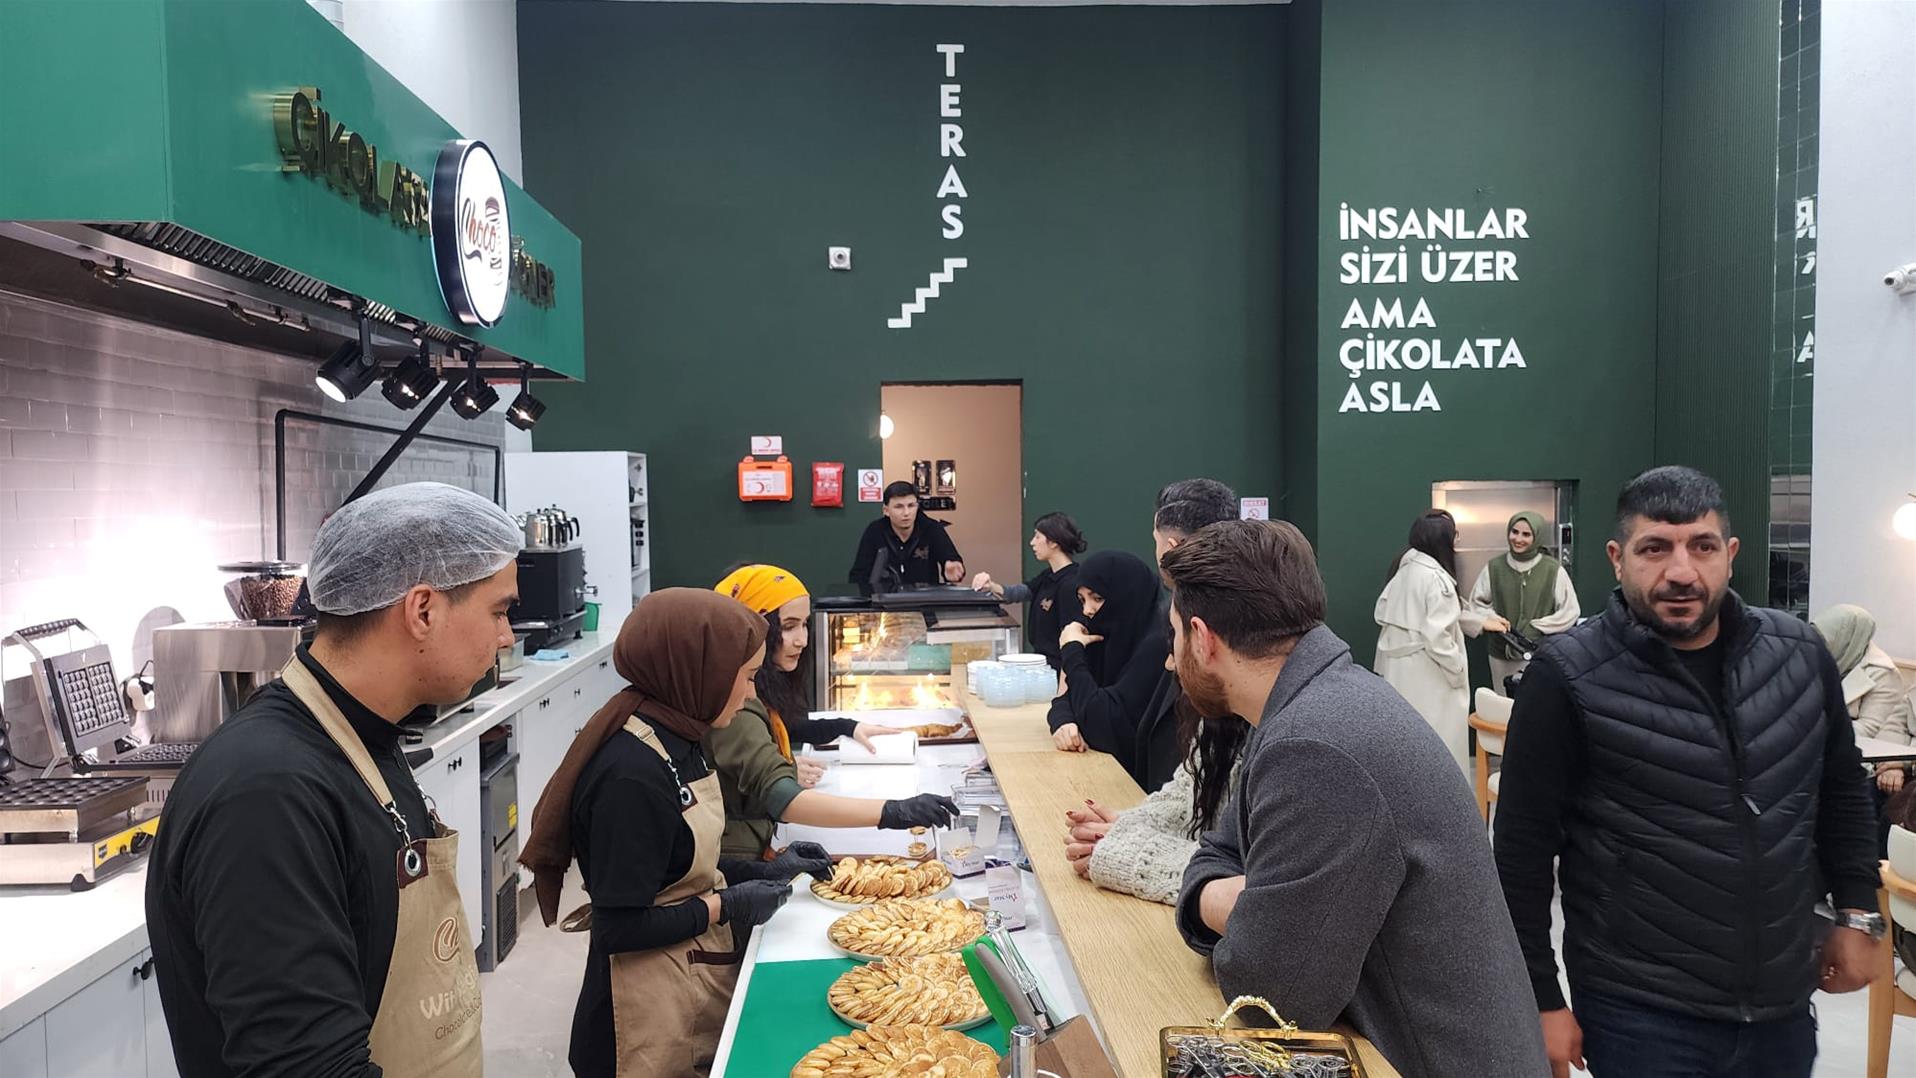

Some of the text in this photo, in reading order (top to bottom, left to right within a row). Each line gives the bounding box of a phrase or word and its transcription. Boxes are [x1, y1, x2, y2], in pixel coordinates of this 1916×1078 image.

[936, 43, 968, 239] TERAS
[1339, 202, 1530, 240] İNSANLAR
[1340, 244, 1520, 284] SİZİ ÜZER
[1340, 296, 1437, 329] AMA
[1339, 332, 1527, 378] ÇİKOLATA
[1338, 380, 1442, 413] ASLA
